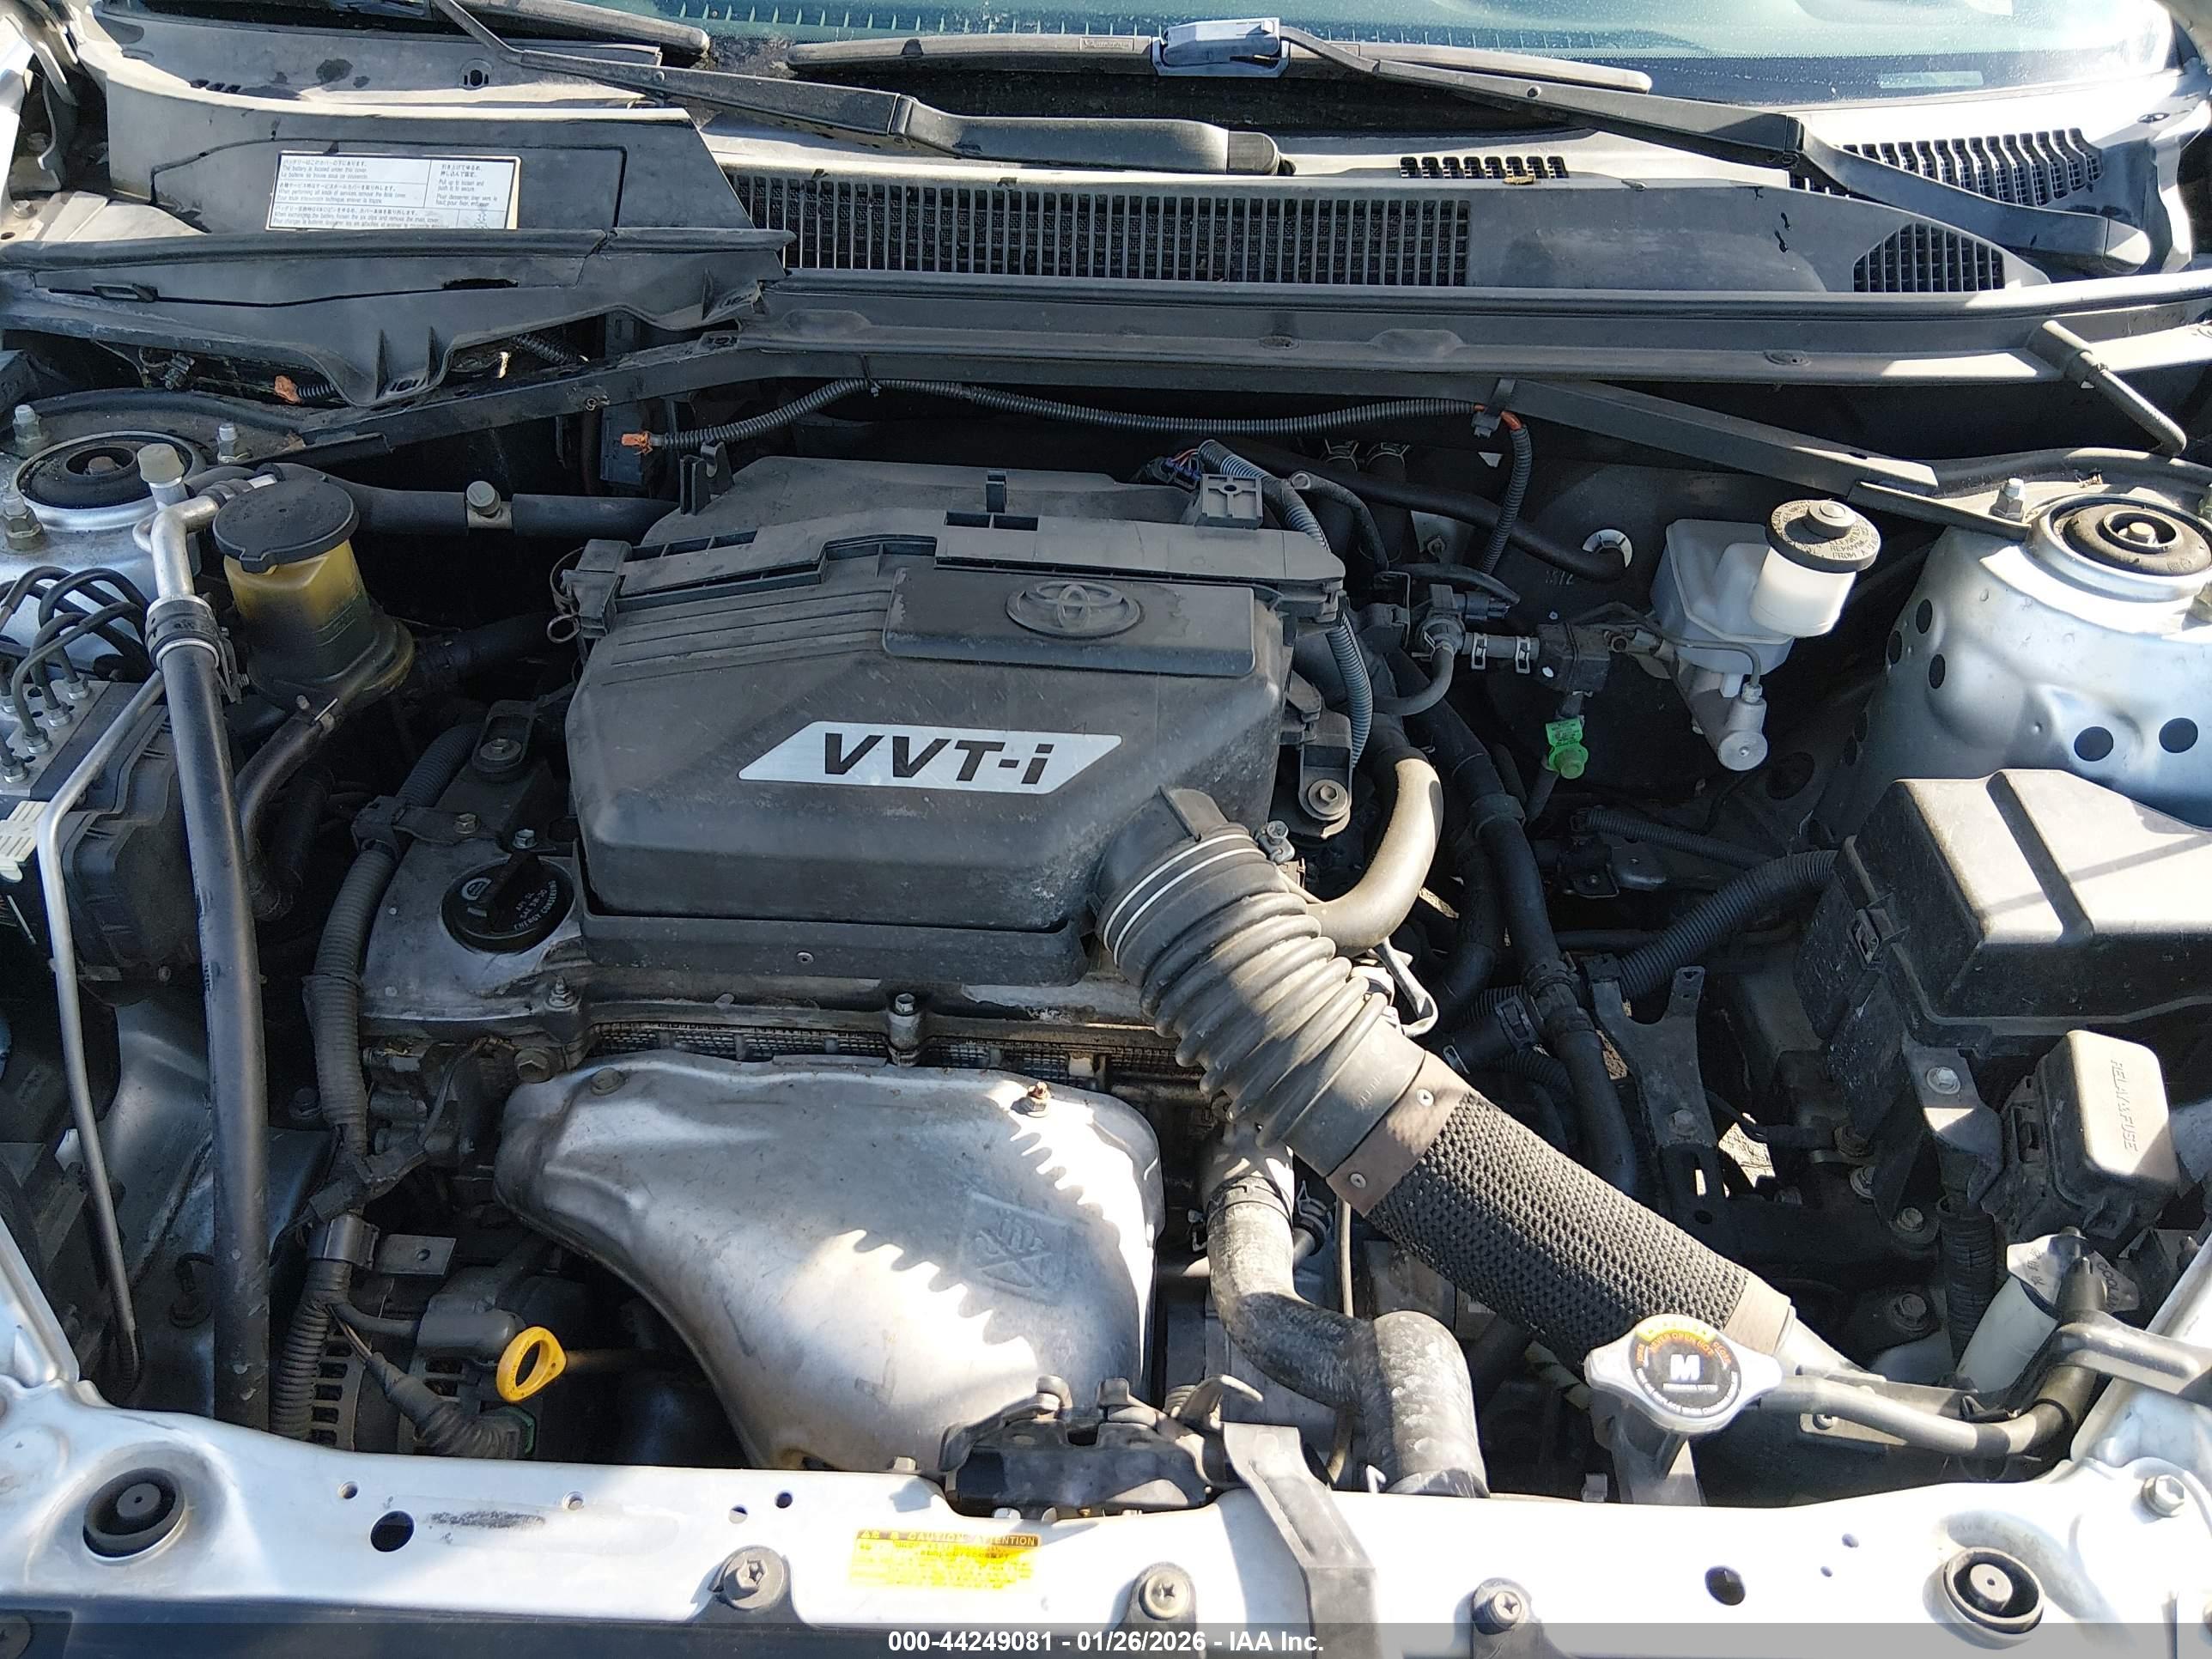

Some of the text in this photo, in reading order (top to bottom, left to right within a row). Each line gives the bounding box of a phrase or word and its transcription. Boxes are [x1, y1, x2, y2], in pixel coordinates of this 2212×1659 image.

[824, 732, 1054, 785] VVT-i
[514, 914, 542, 930] ENERGY
[1670, 1353, 1701, 1382] M
[974, 1534, 1036, 1547] ATTENTION
